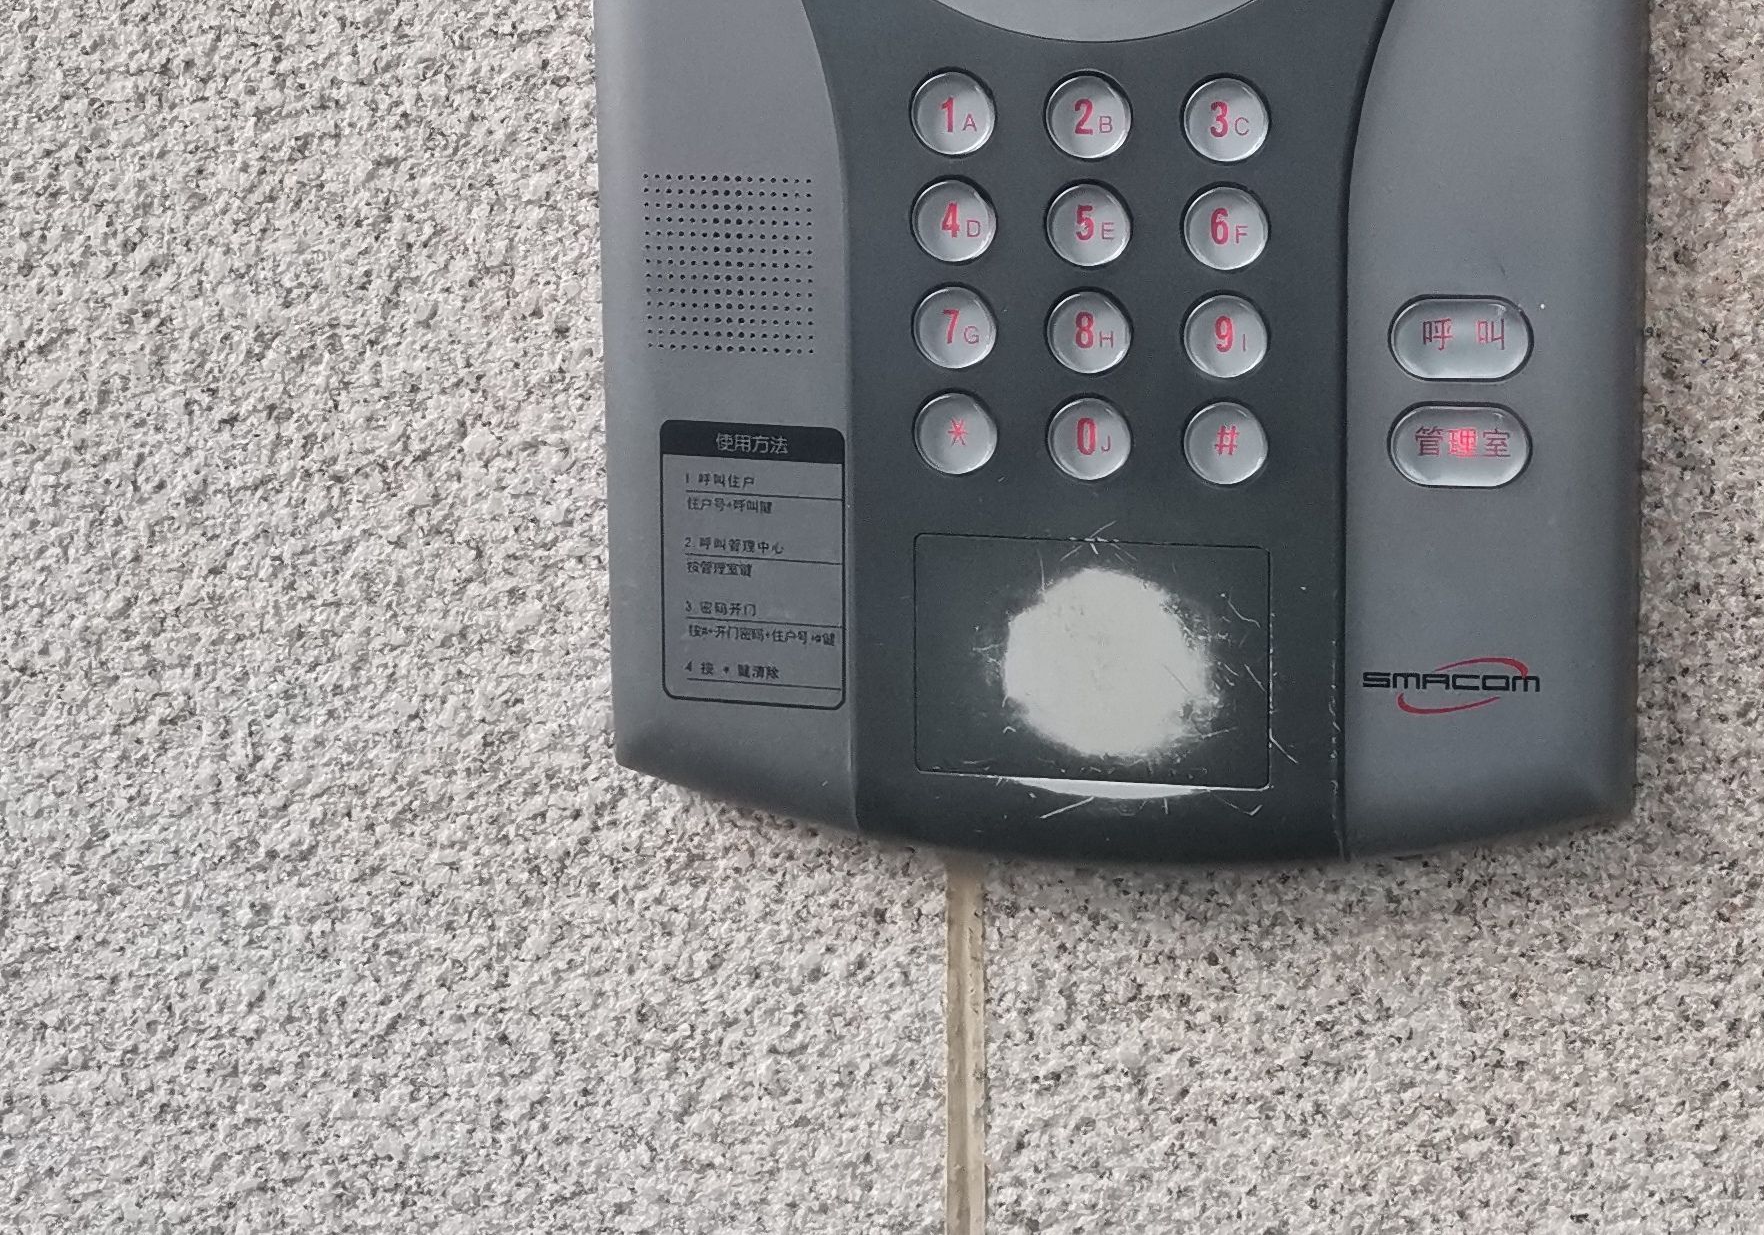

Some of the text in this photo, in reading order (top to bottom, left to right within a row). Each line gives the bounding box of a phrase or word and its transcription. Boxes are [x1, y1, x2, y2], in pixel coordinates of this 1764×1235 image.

[715, 432, 788, 454] 使用方法
[1415, 426, 1511, 458] 管理室
